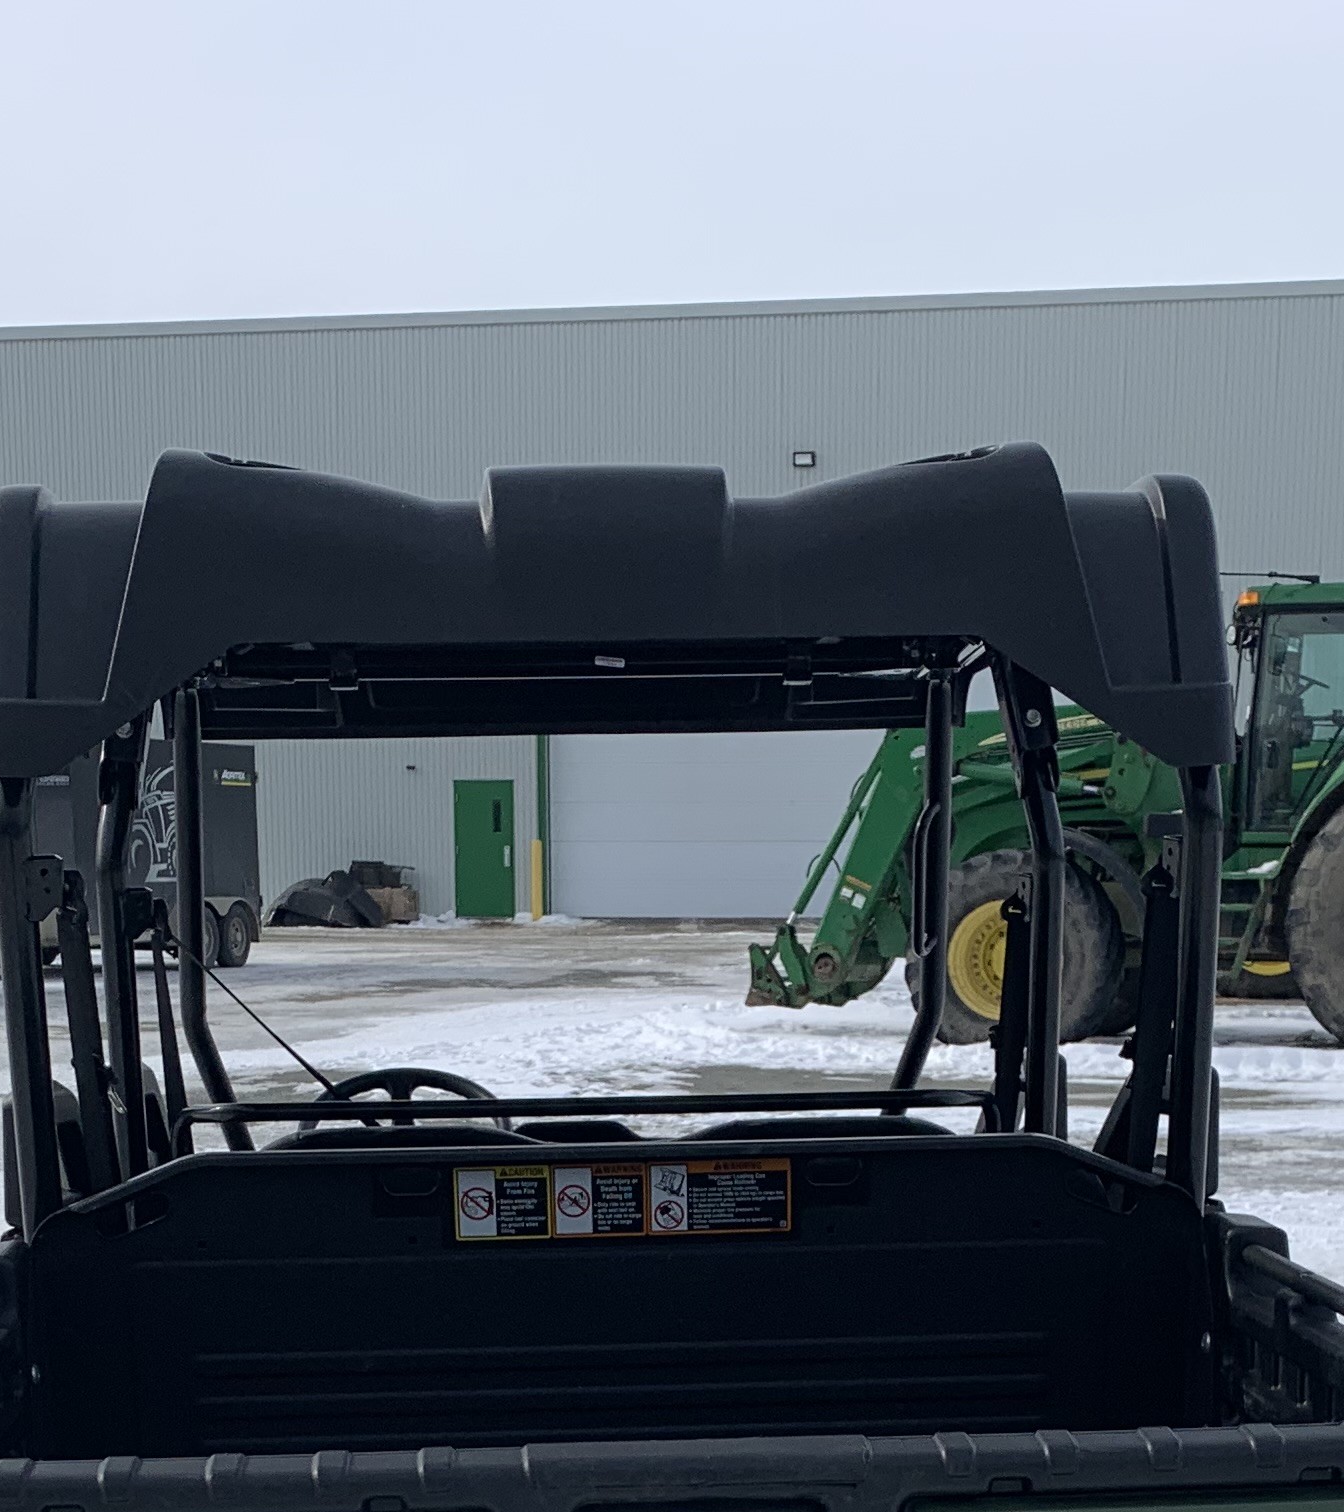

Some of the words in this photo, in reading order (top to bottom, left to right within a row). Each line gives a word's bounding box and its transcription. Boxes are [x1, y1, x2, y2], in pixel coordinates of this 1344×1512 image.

[603, 1165, 642, 1173] WARNING
[722, 1162, 763, 1170] WARNING
[509, 1167, 544, 1176] CAUTION
